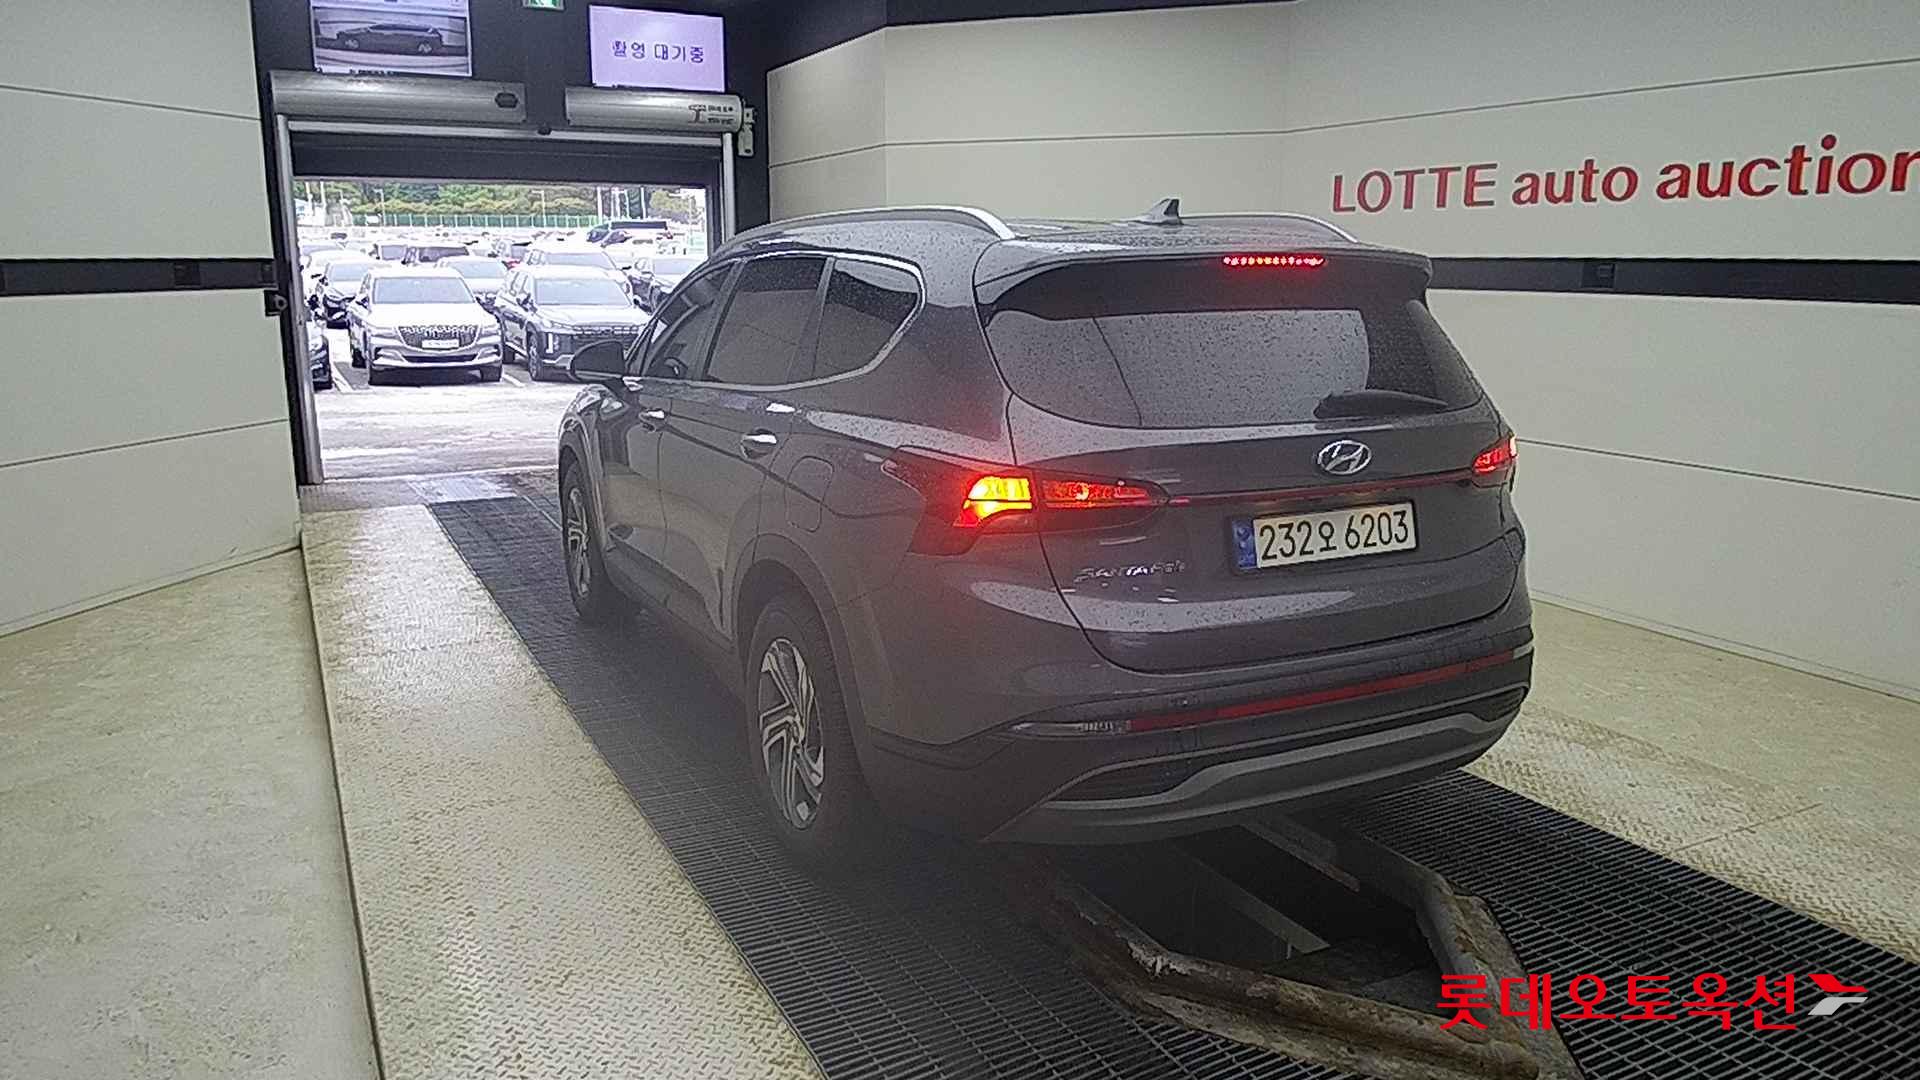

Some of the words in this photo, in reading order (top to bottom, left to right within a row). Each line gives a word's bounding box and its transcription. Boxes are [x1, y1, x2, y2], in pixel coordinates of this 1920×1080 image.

[654, 44, 704, 63] 대기중
[1332, 163, 1498, 213] LOTTE
[1511, 159, 1639, 206] auto
[1260, 521, 1338, 560] 232오
[1345, 510, 1409, 550] 6203
